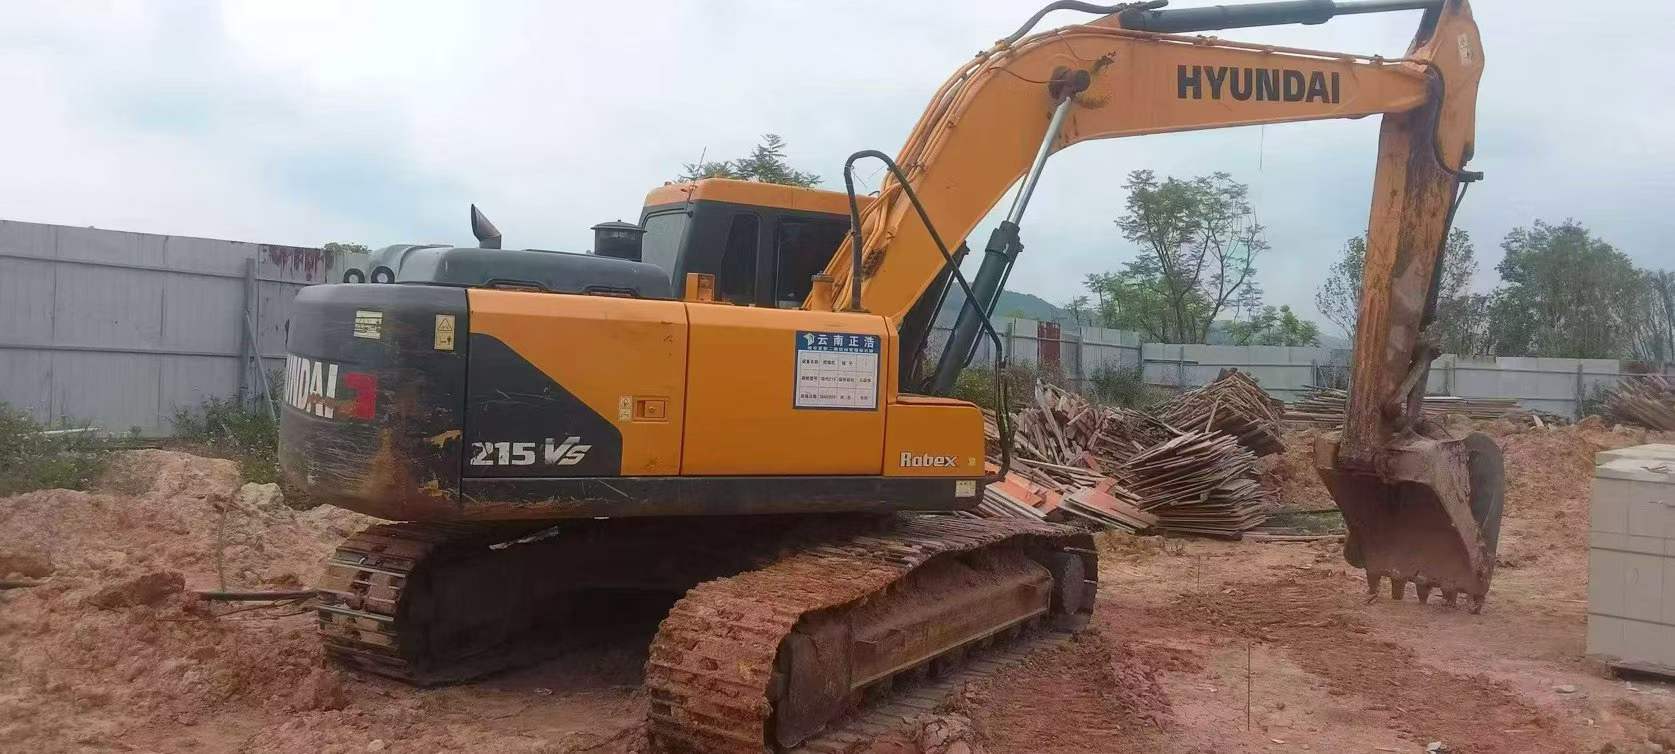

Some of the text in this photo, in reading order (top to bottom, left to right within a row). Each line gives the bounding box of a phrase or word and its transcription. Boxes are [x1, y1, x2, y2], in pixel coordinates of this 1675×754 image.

[1177, 65, 1340, 104] HYUNDAI
[817, 334, 875, 348] 云南正浩
[470, 442, 536, 465] 215
